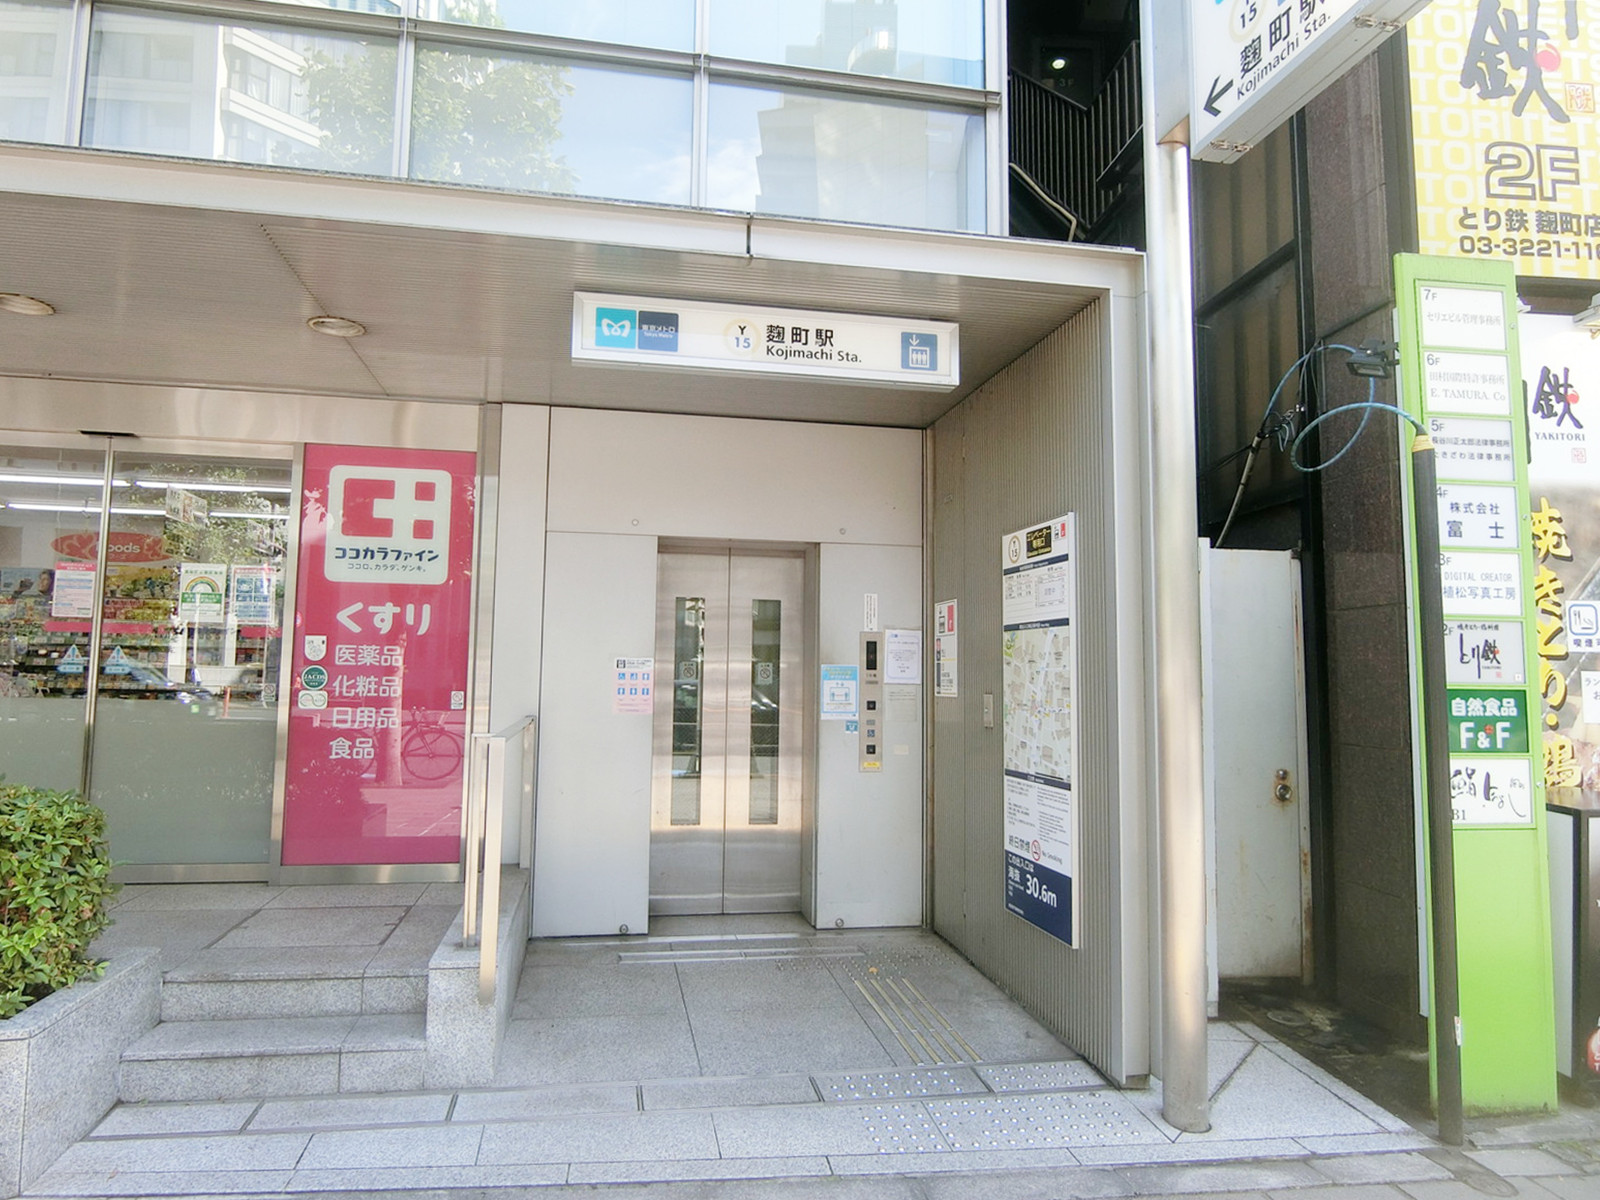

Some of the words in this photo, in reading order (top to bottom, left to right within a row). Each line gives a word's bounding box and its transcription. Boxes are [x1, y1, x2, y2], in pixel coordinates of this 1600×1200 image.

[1237, 33, 1299, 100] Kojimachi
[1304, 13, 1331, 40] Sta.
[1485, 141, 1580, 201] 2F
[1459, 207, 1529, 233] とり鉄
[1424, 288, 1437, 300] 7F
[642, 324, 675, 333] 東京メトロ
[738, 325, 746, 335] Y
[735, 336, 751, 349] 15
[766, 345, 832, 360] Kojimachi
[837, 350, 862, 362] Sta.
[1426, 354, 1440, 366] 6F
[1431, 420, 1444, 432] 5F
[1535, 432, 1586, 442] YAKITORI
[1450, 502, 1500, 515] 株式会社
[334, 547, 439, 562] ココカラファイン
[1444, 571, 1476, 582] DIGITAL
[1480, 572, 1513, 583] CREATOR
[336, 602, 431, 635] くすり
[335, 645, 403, 667] 医薬品
[332, 675, 400, 697] 化粧品
[1451, 697, 1518, 717] 自然食品
[332, 707, 399, 728] 日用品
[329, 737, 375, 759] 食品
[1025, 873, 1058, 908] 30.6m
